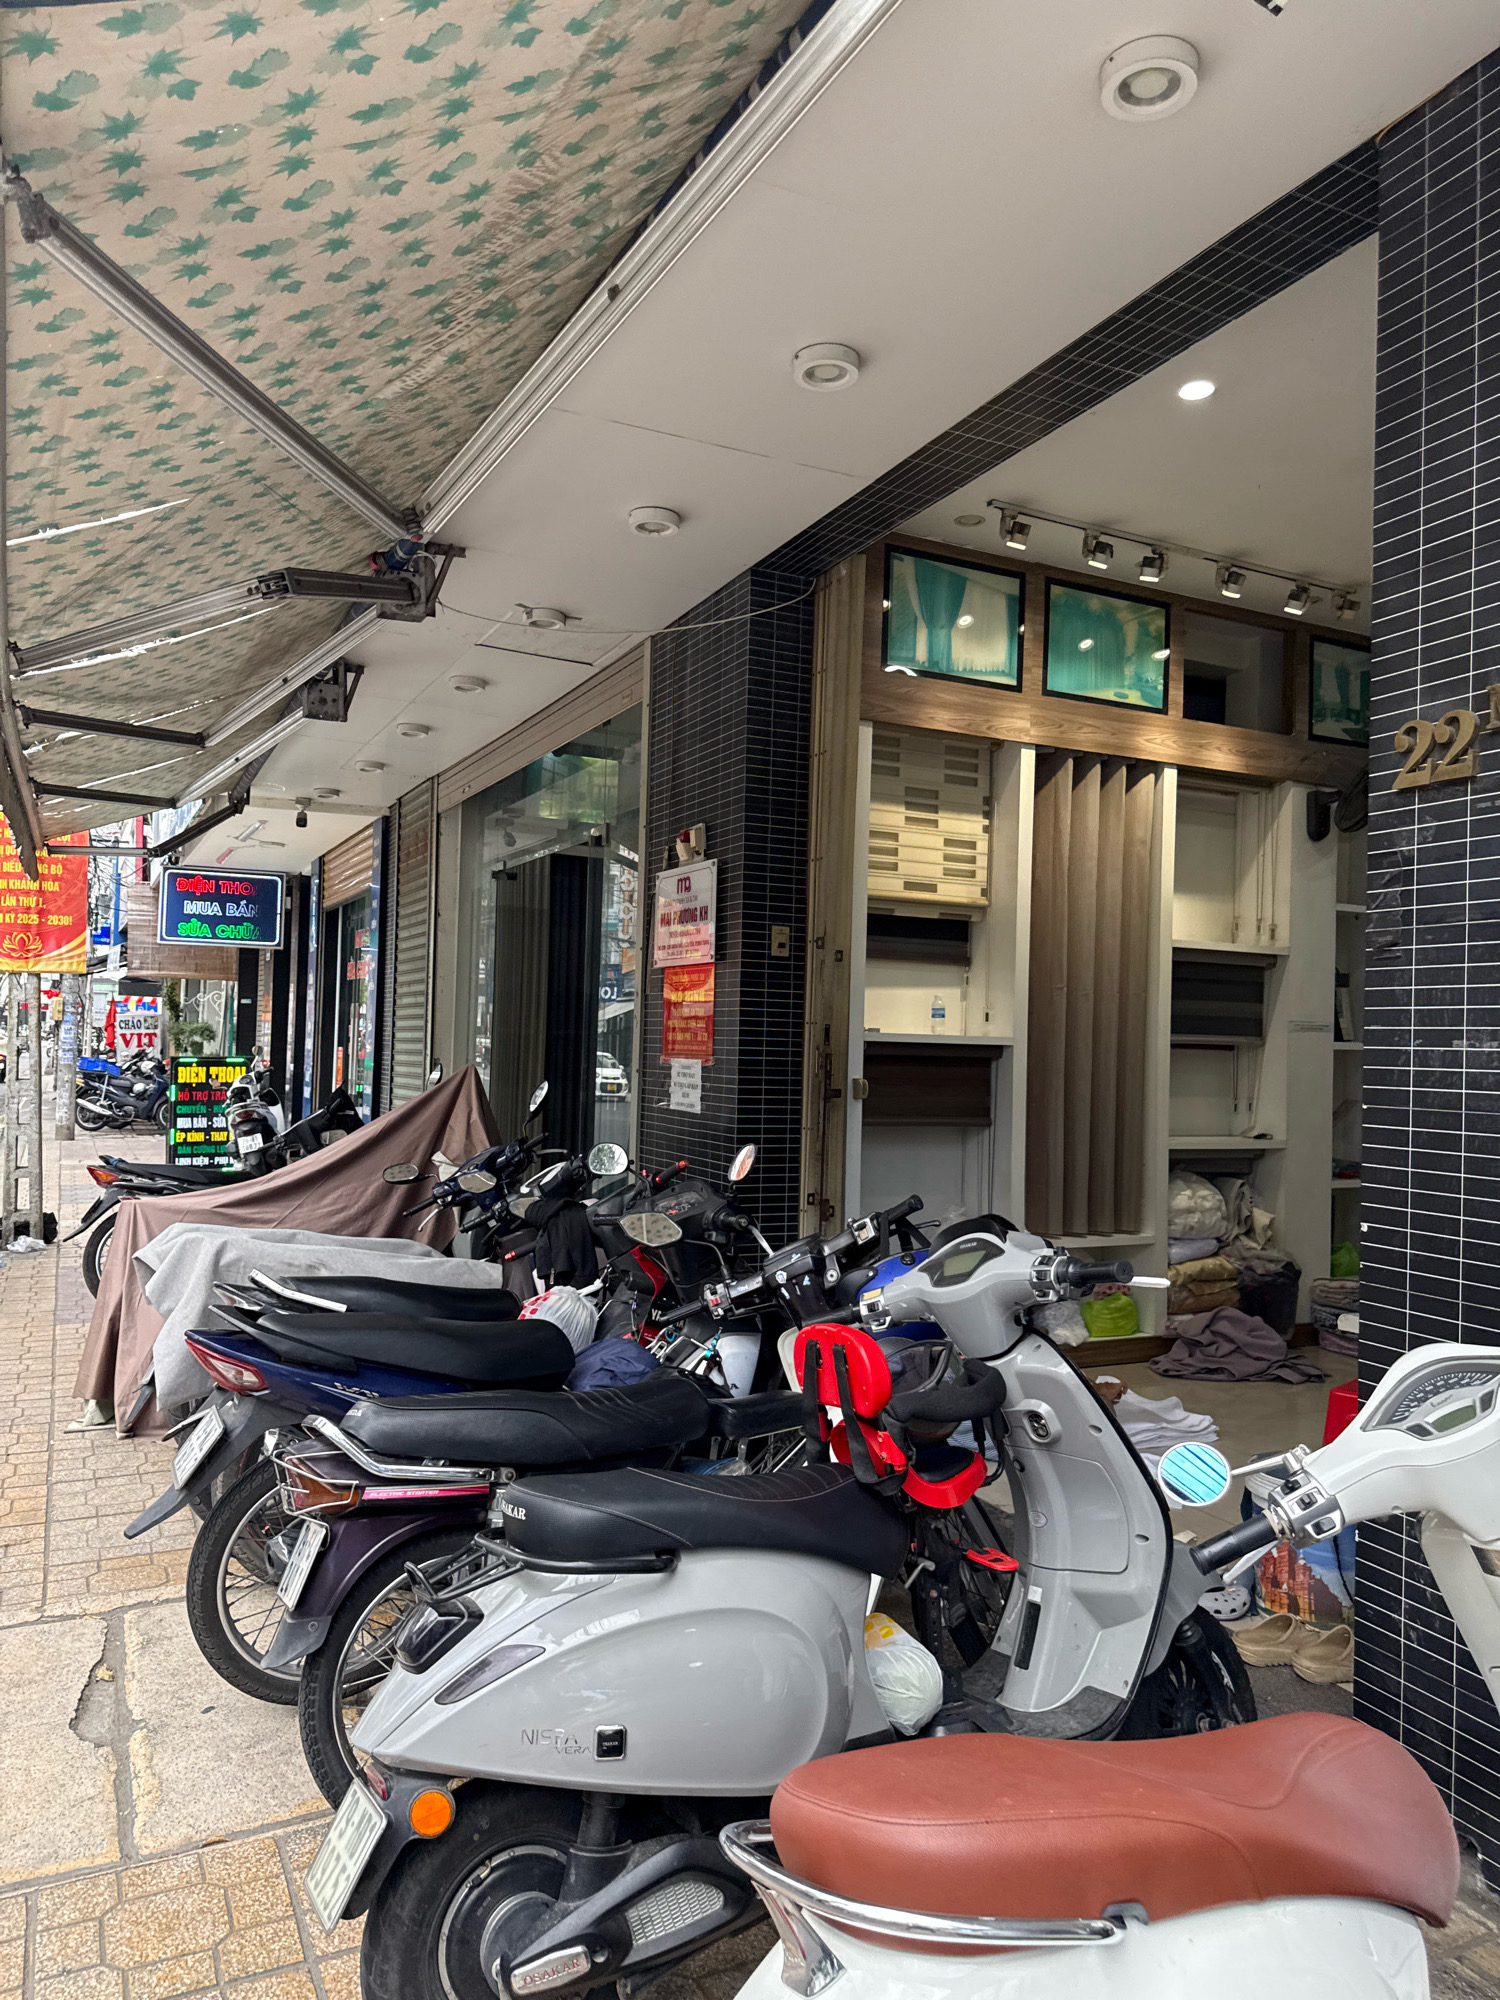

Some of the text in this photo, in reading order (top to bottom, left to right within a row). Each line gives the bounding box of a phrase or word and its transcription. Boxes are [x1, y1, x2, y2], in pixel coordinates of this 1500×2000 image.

[1392, 709, 1479, 789] 22
[51, 862, 63, 877] BỘ
[176, 874, 215, 896] ĐIỆN
[183, 899, 258, 917] MUA BÁN
[17, 913, 40, 925] 2025
[47, 915, 73, 926] 2030!
[177, 918, 212, 937] SỬA
[178, 1063, 207, 1087] ĐIỆN
[521, 1728, 578, 1745] NISPA
[555, 1746, 592, 1755] VERA
[523, 1960, 581, 1986] OSAKAR
